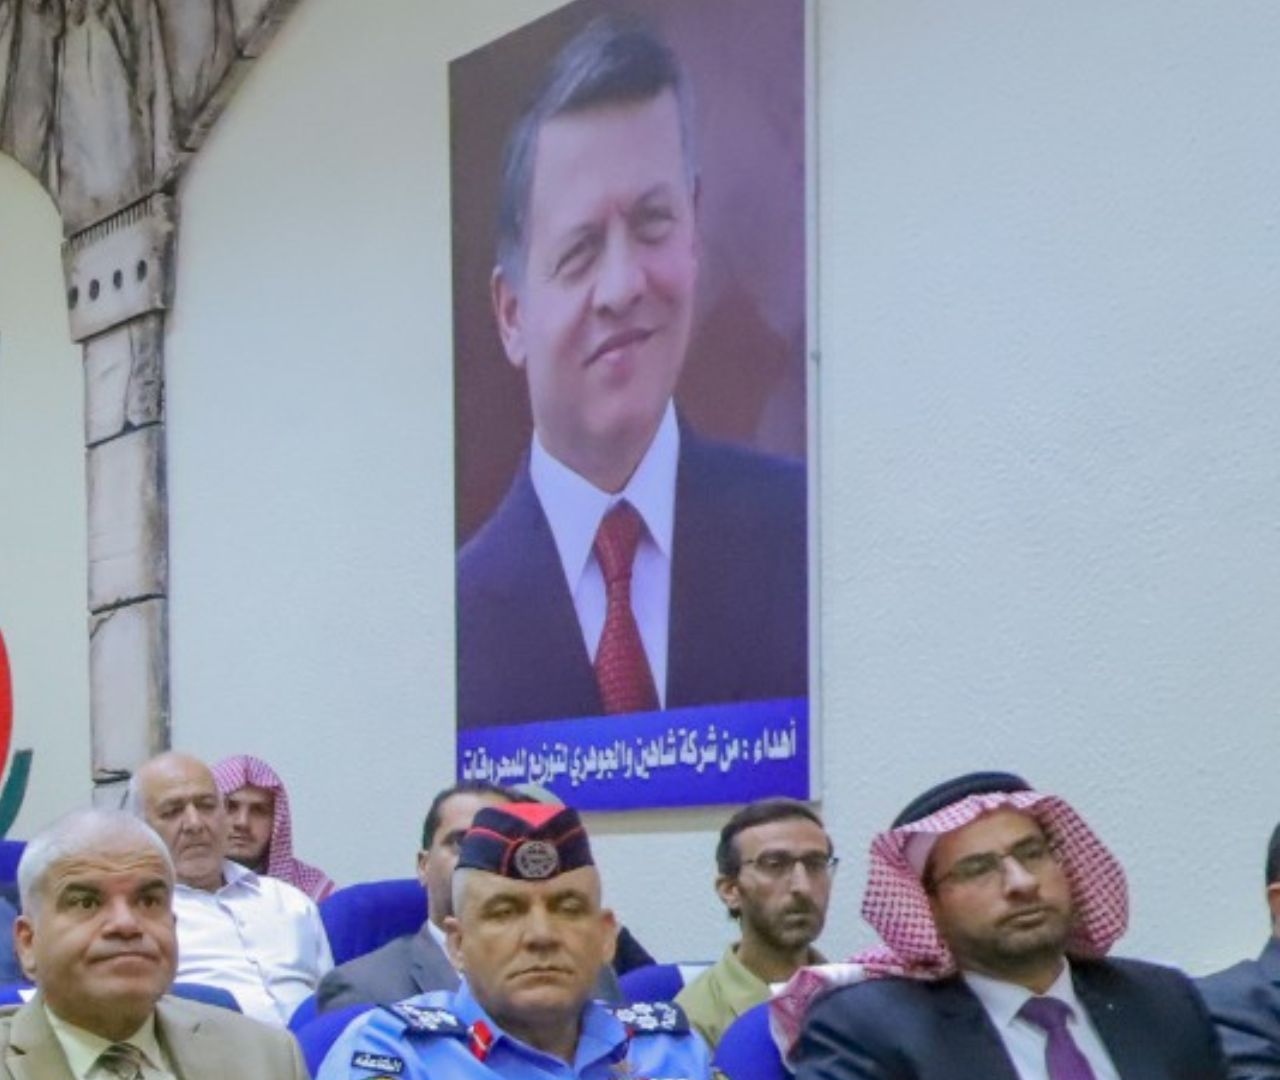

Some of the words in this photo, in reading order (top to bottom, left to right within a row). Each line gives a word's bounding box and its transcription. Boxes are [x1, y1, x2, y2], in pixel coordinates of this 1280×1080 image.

[463, 746, 527, 785] للمحروقات
[570, 739, 633, 787] والجوهري
[634, 728, 677, 779] شاهين
[679, 724, 718, 773] شركة
[720, 730, 740, 772] من
